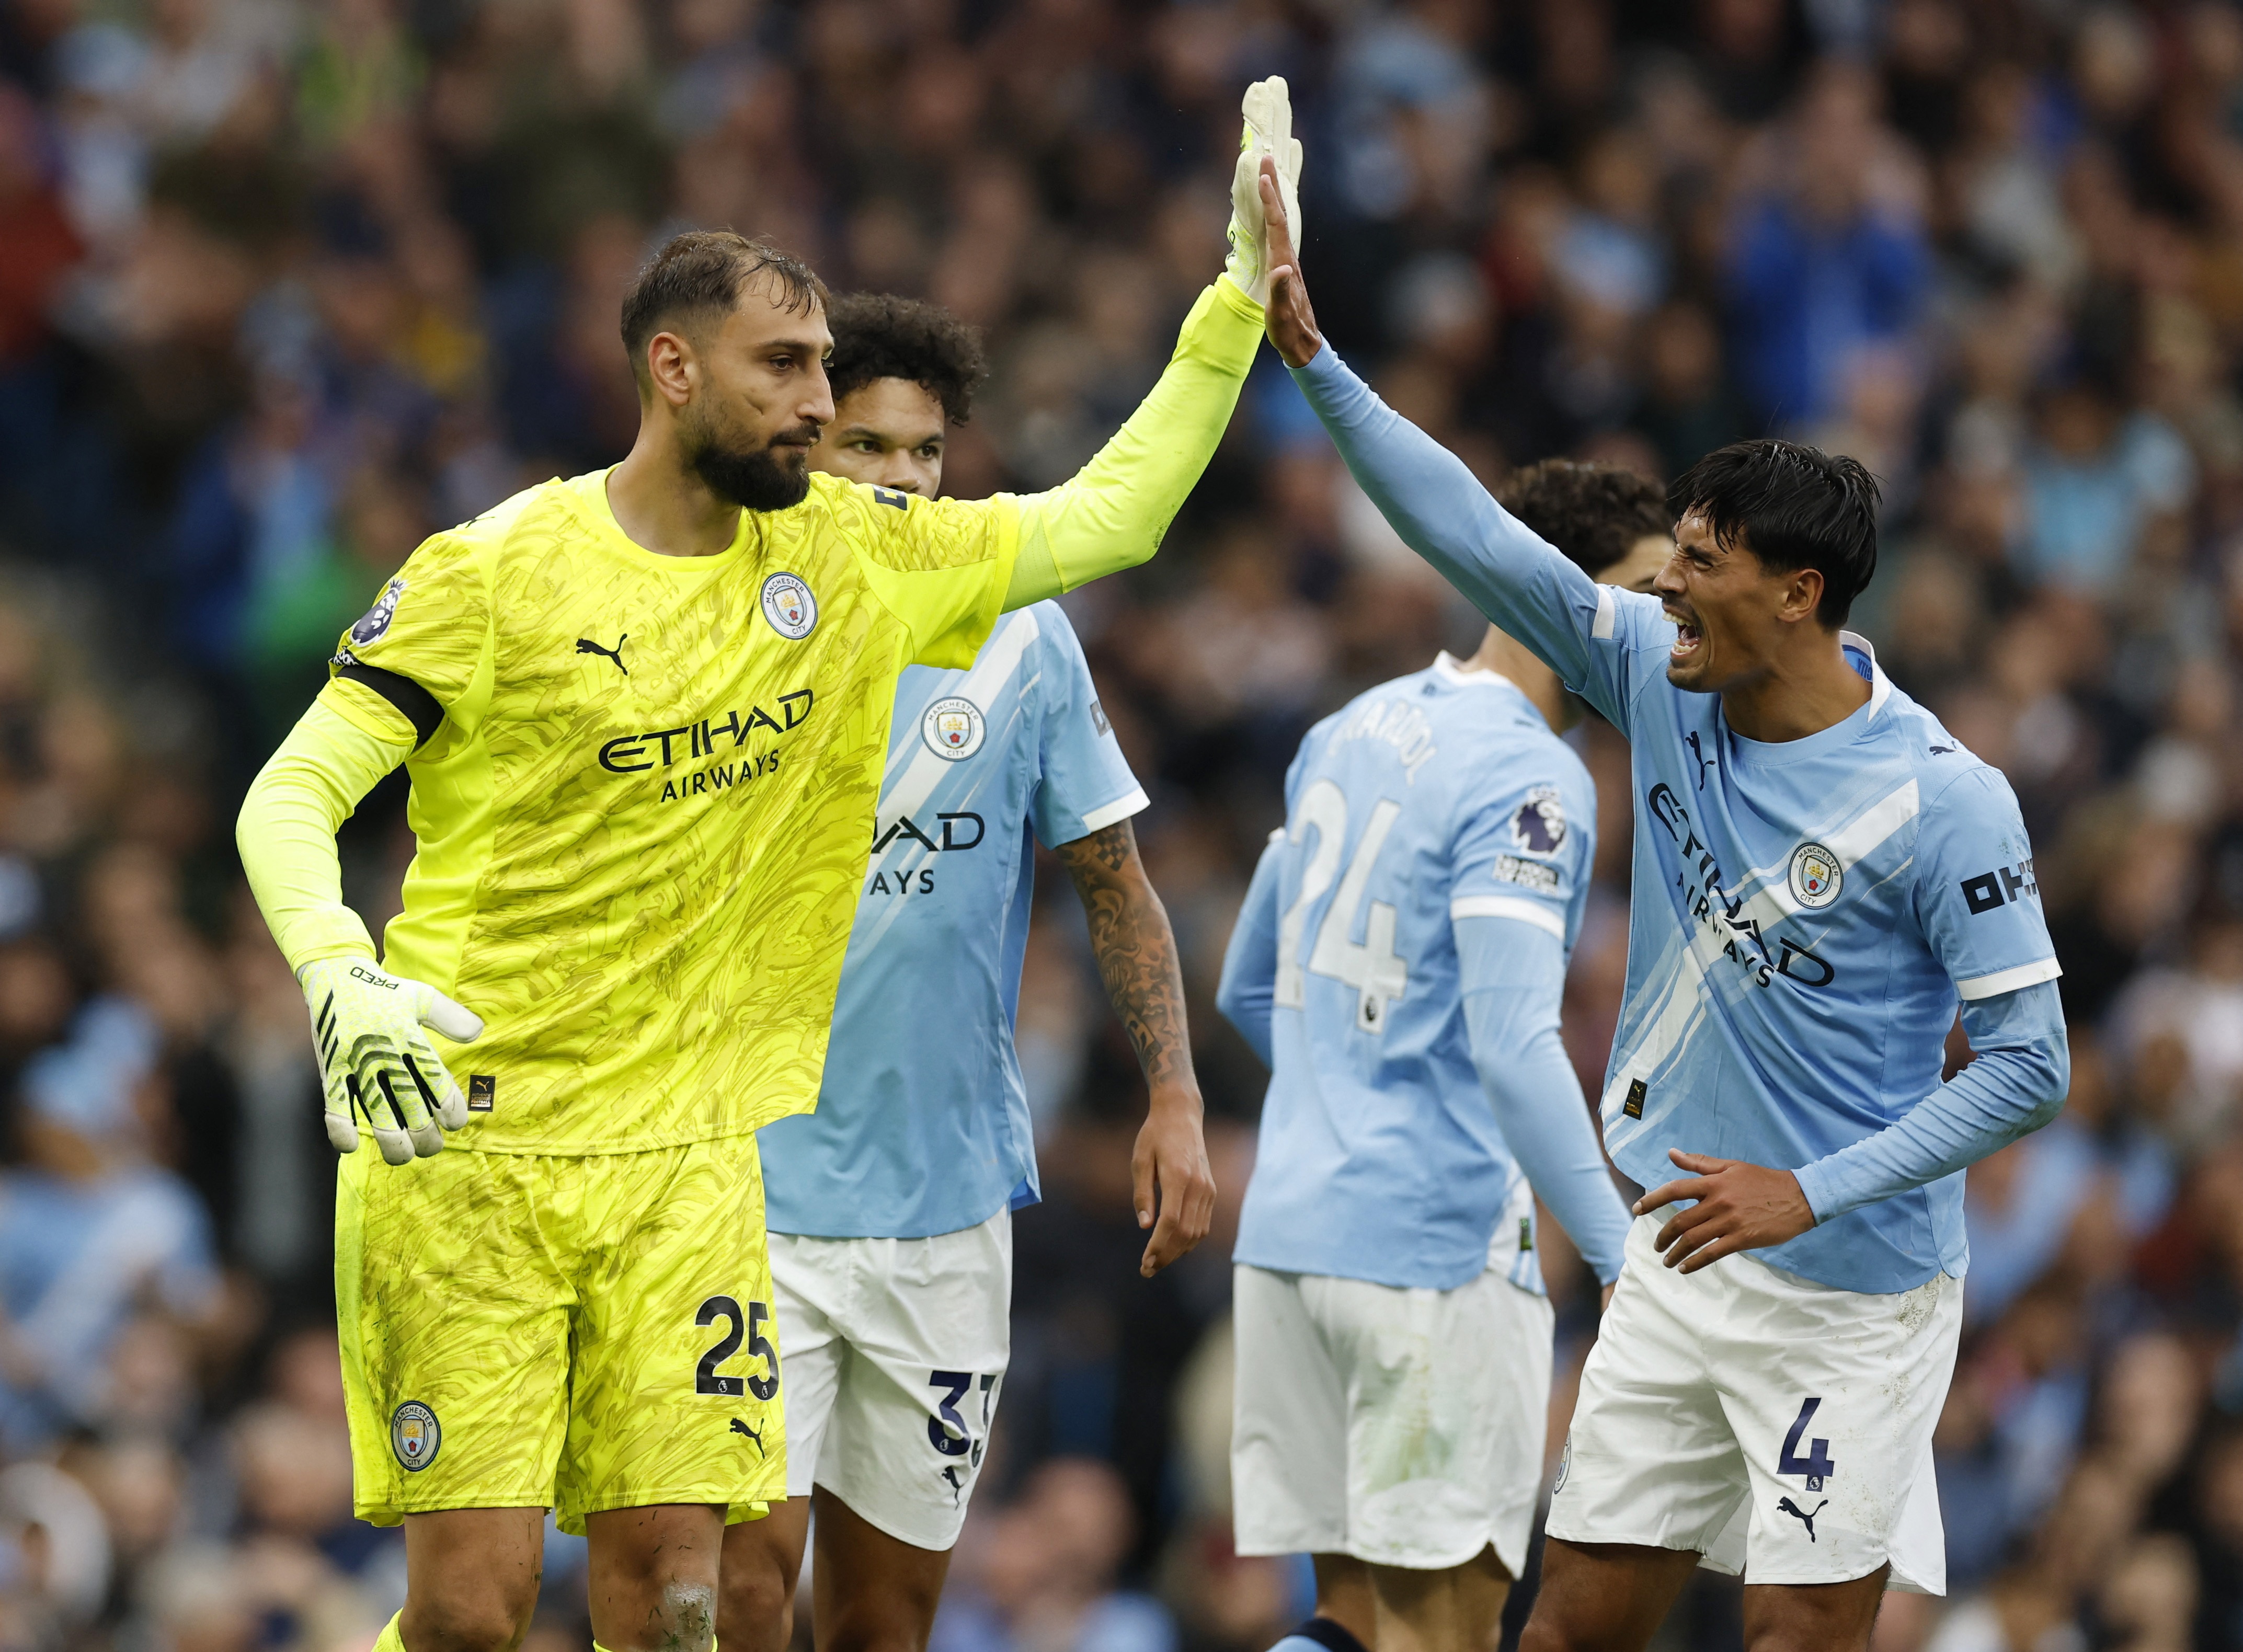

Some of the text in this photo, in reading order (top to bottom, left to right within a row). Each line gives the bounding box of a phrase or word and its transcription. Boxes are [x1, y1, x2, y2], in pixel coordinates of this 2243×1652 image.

[766, 578, 804, 603] MANCHESTER
[792, 625, 806, 634] CITY
[928, 702, 978, 721] MANCHESTER
[599, 689, 814, 773] ETIHAD
[661, 749, 779, 802] AIRWAYS
[1799, 847, 1839, 877] MANCHESTER
[1274, 778, 1408, 1035] 24
[1800, 894, 1816, 905] CITY
[350, 967, 399, 990] PRED
[695, 1295, 779, 1402] 25
[395, 1407, 433, 1428] MANCHESTER
[1776, 1397, 1835, 1492] 4
